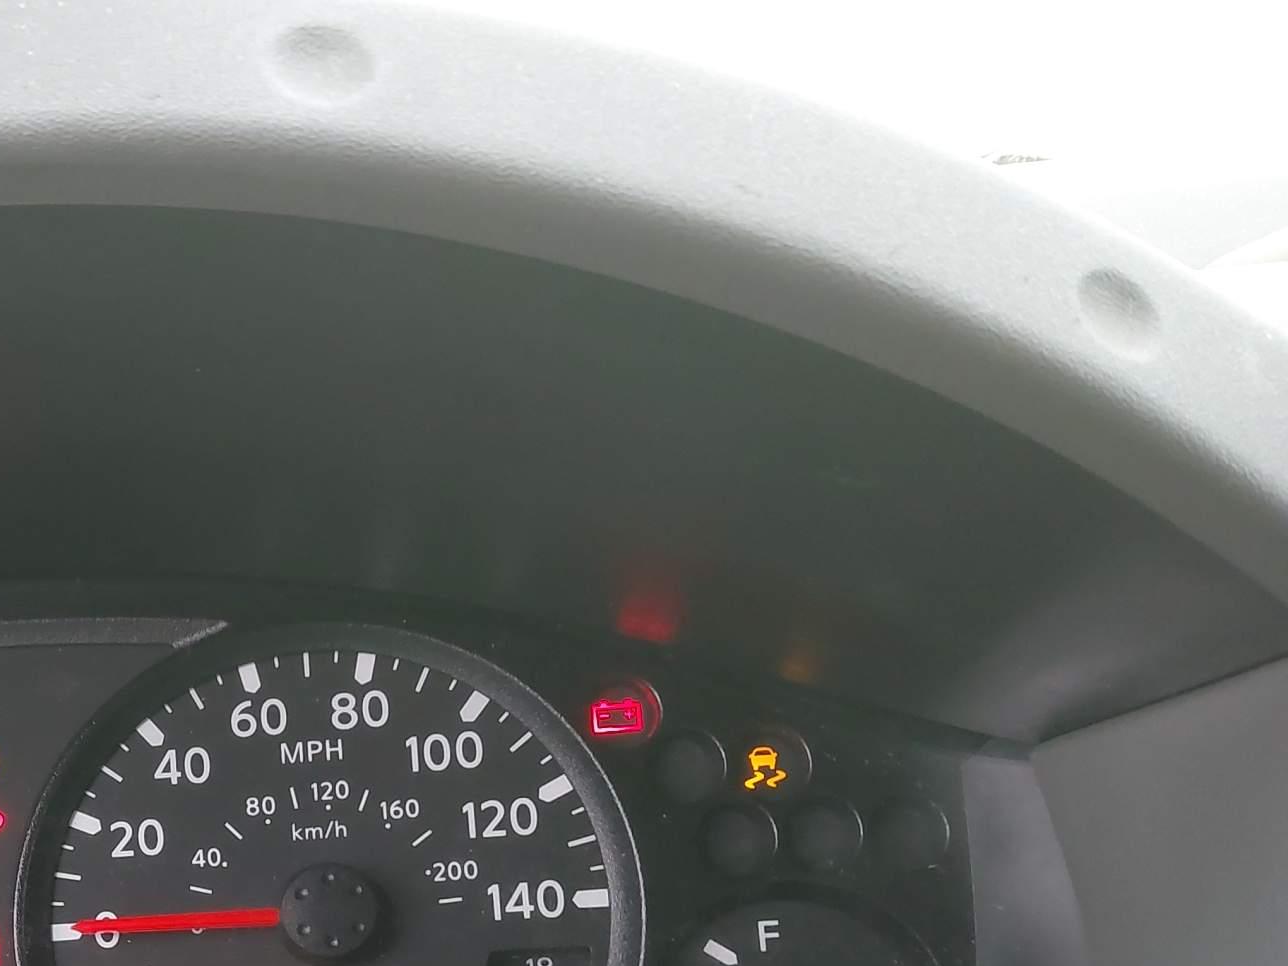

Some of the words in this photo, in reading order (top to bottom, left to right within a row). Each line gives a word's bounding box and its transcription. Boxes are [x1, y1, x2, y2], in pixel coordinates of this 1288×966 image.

[230, 698, 287, 738] 60
[331, 690, 389, 730] 80
[154, 746, 211, 785] 40
[280, 738, 344, 765] MPH
[405, 730, 483, 773] 100
[246, 796, 276, 817] 80
[310, 780, 350, 801] 120
[380, 798, 420, 820] 160
[462, 797, 539, 838] 120
[110, 818, 164, 858] 20
[291, 820, 347, 841] km/h
[191, 847, 221, 868] 40
[432, 860, 478, 882] 200
[487, 879, 565, 921] 140
[94, 911, 119, 948] 0
[757, 919, 780, 952] F
